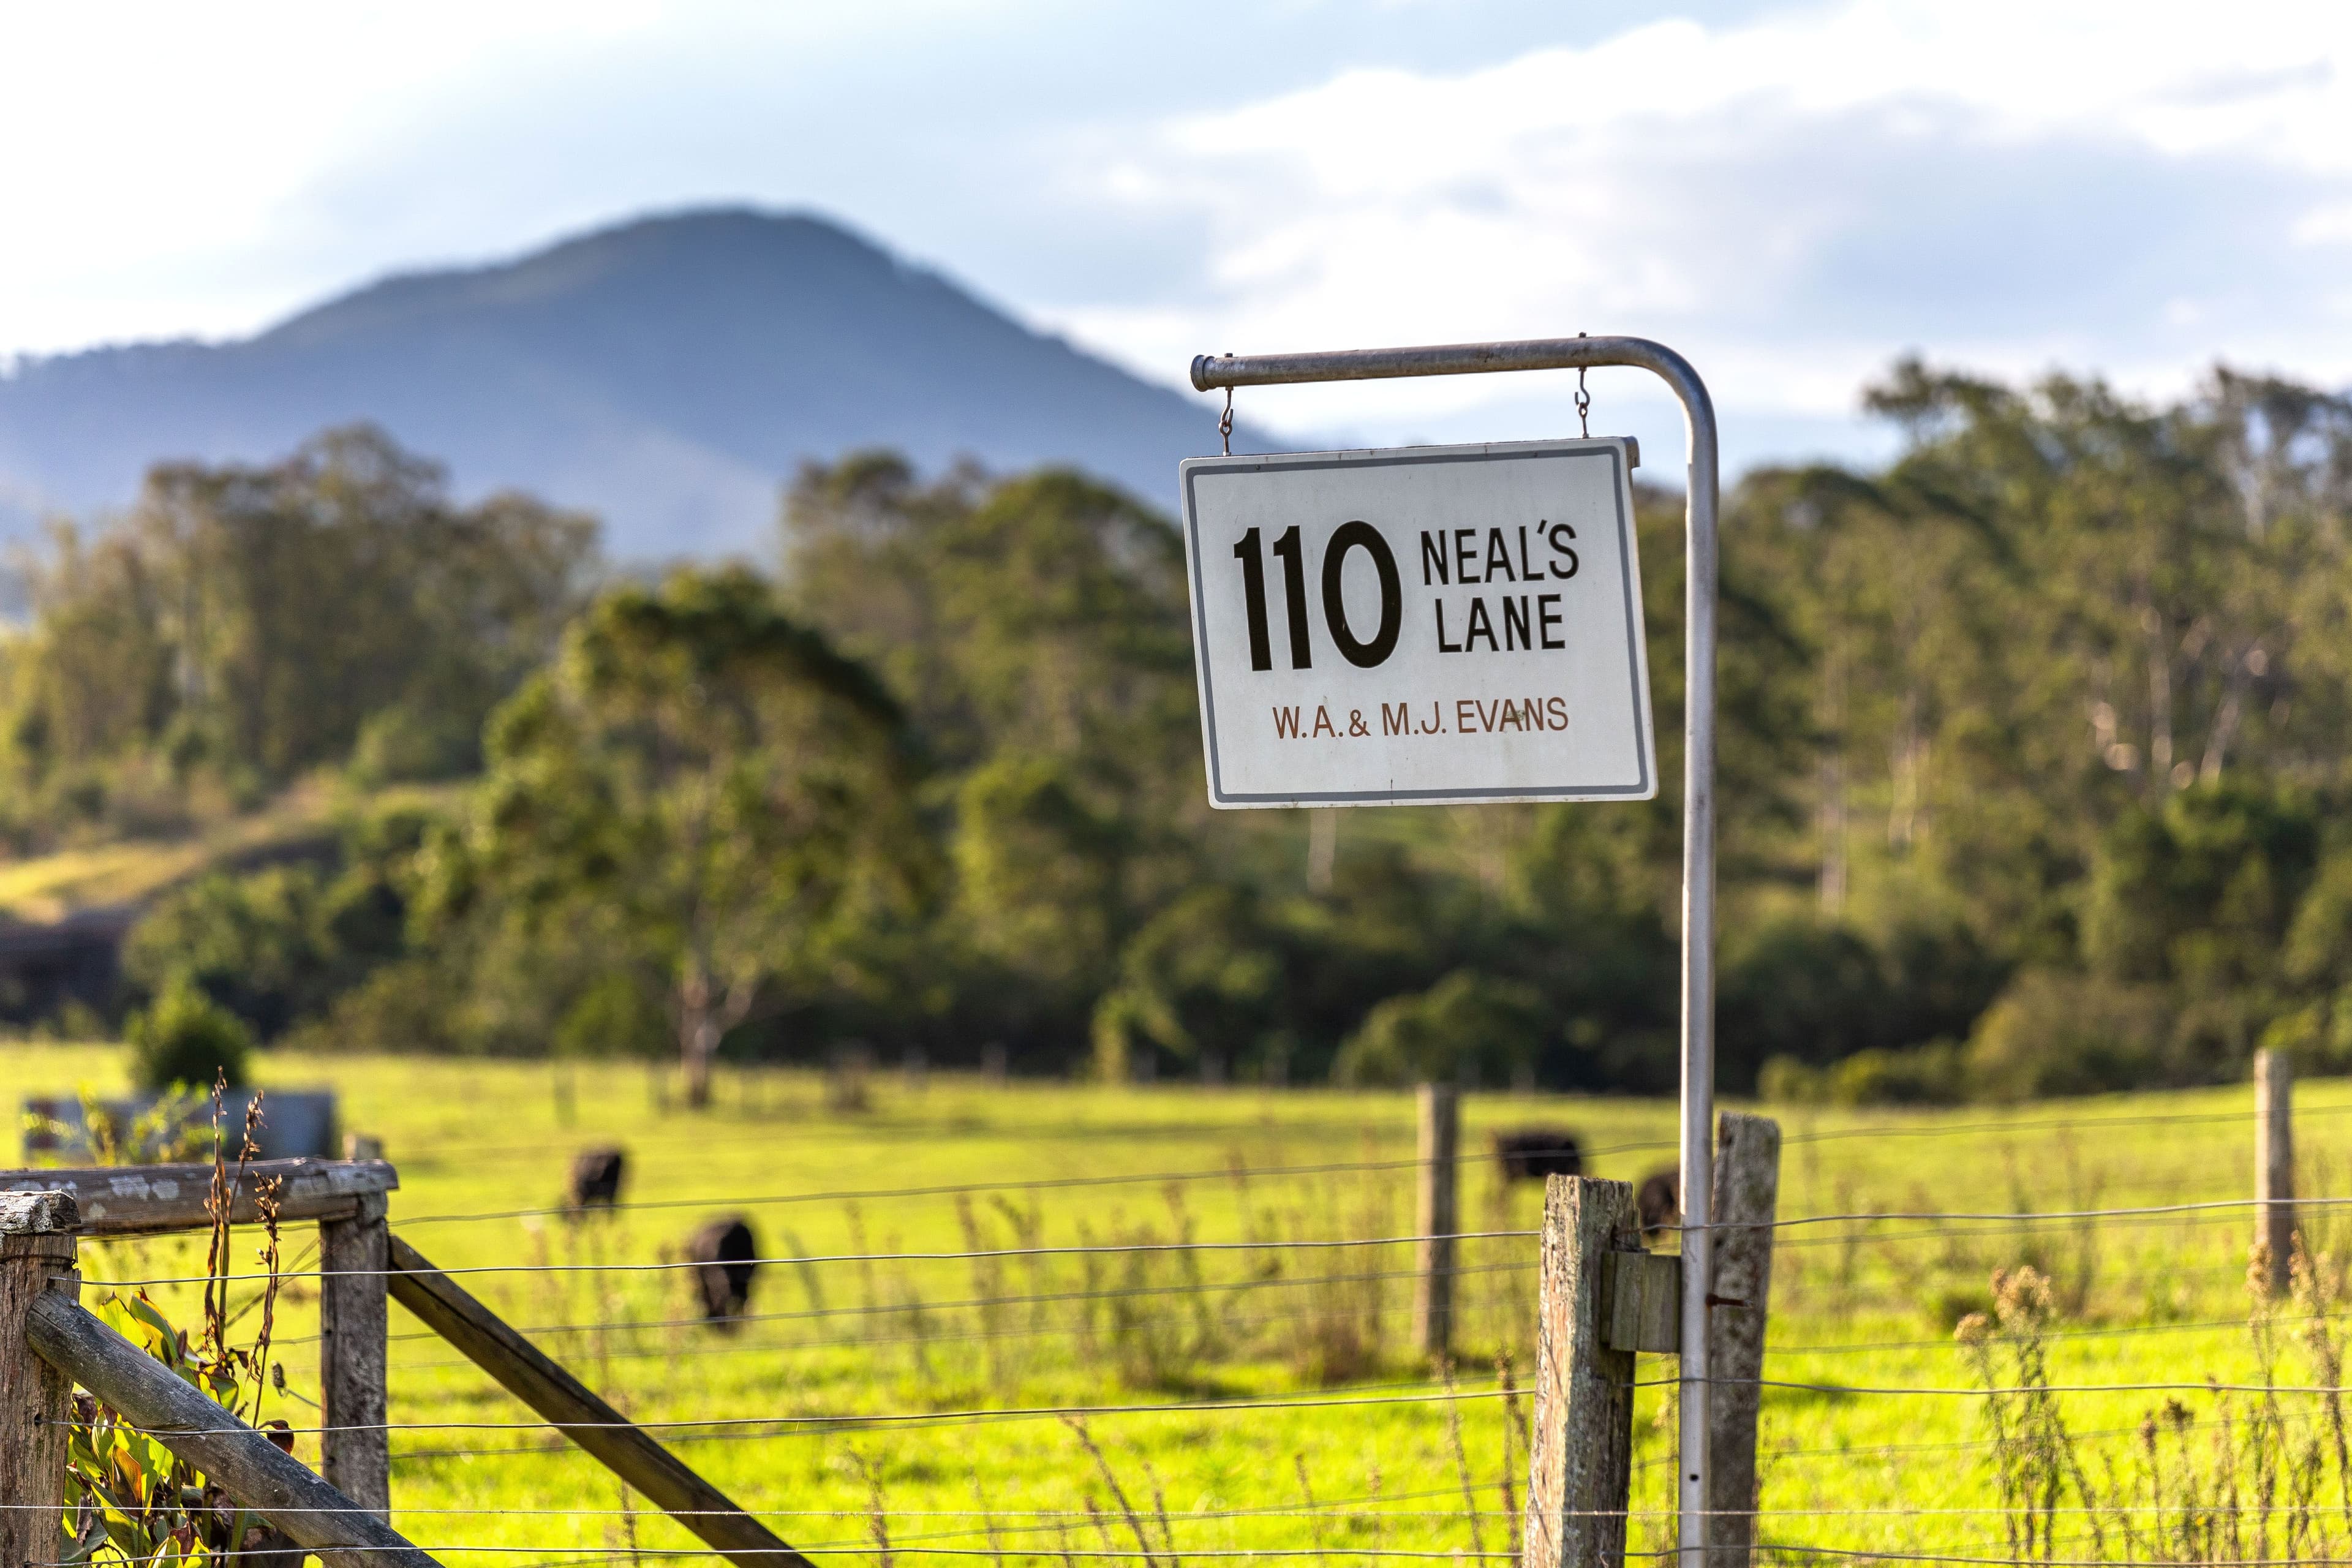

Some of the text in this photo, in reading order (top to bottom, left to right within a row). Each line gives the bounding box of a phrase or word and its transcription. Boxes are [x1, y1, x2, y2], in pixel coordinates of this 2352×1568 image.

[1420, 519, 1580, 586] NEAL'S
[1233, 520, 1403, 672] 110
[1435, 594, 1566, 654] LANE
[1381, 701, 1447, 736] M.J.
[1457, 697, 1569, 733] EVANS
